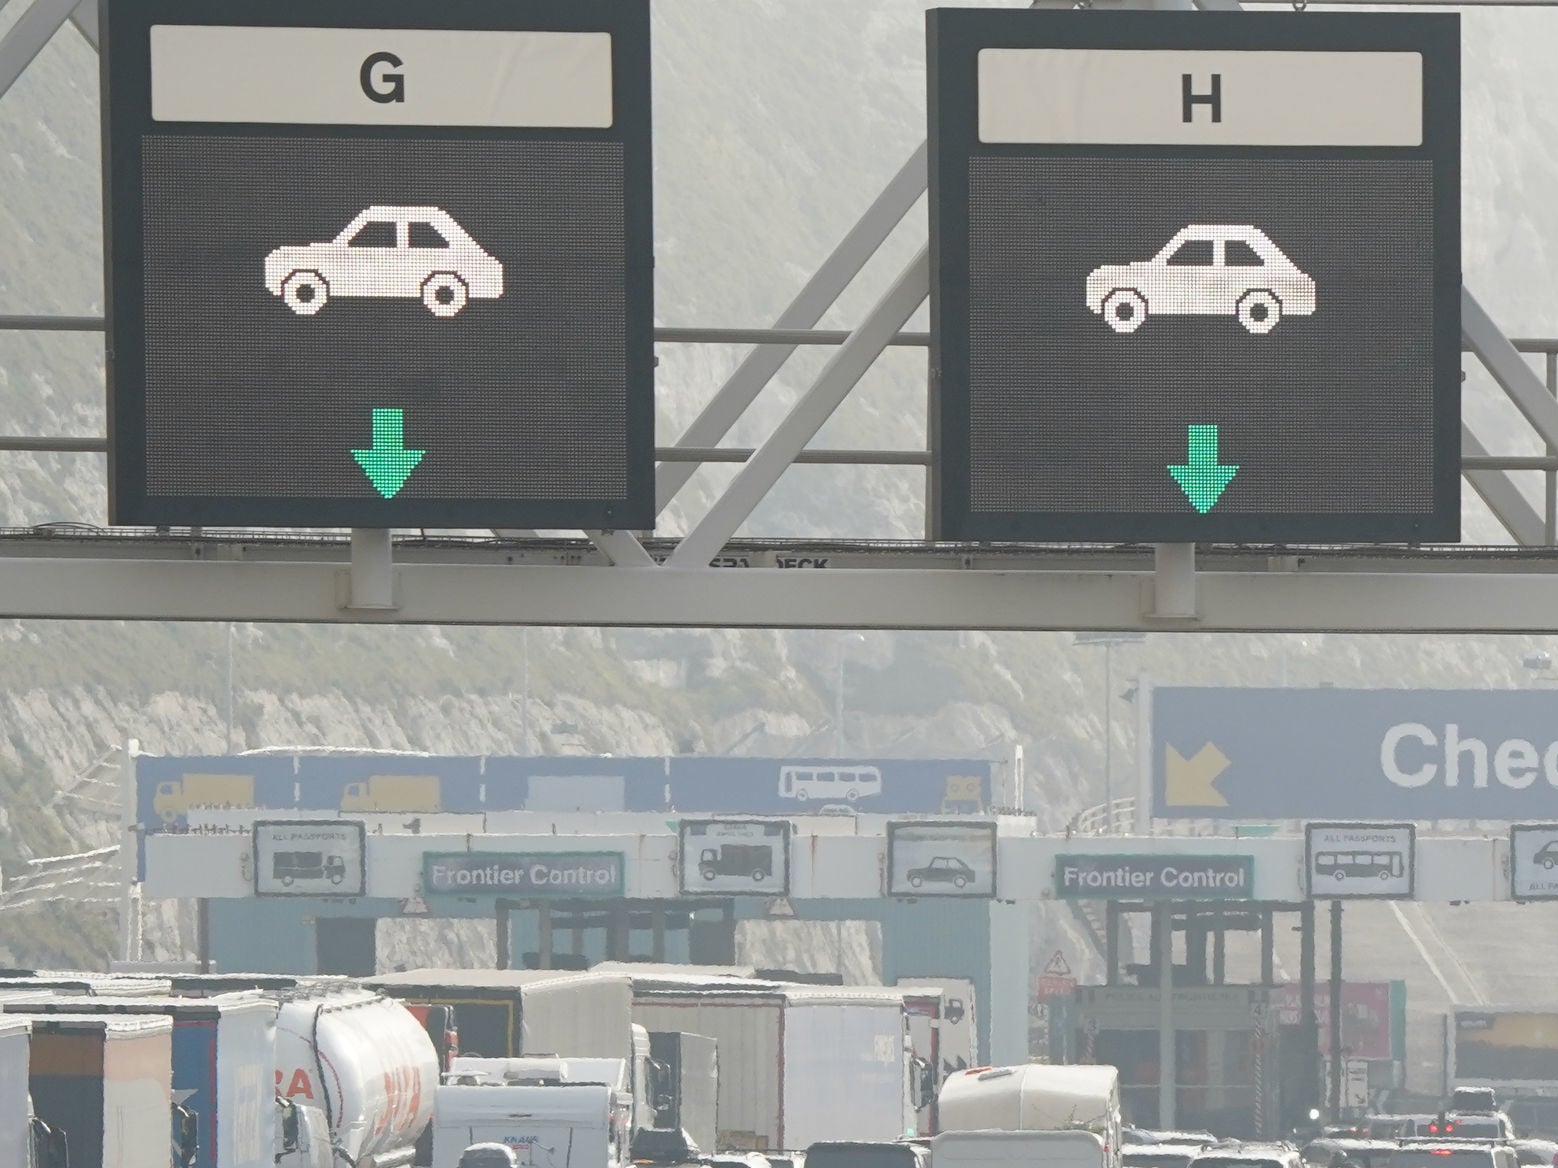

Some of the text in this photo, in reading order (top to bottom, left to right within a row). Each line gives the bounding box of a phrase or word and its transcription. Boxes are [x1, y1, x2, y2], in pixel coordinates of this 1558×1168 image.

[359, 51, 405, 104] G
[1181, 73, 1222, 123] H
[1323, 834, 1397, 844] ALL PASSPORTS
[431, 863, 616, 886] Frontier Control
[1063, 866, 1245, 888] Frontier Control
[1528, 882, 1546, 892] ALL
